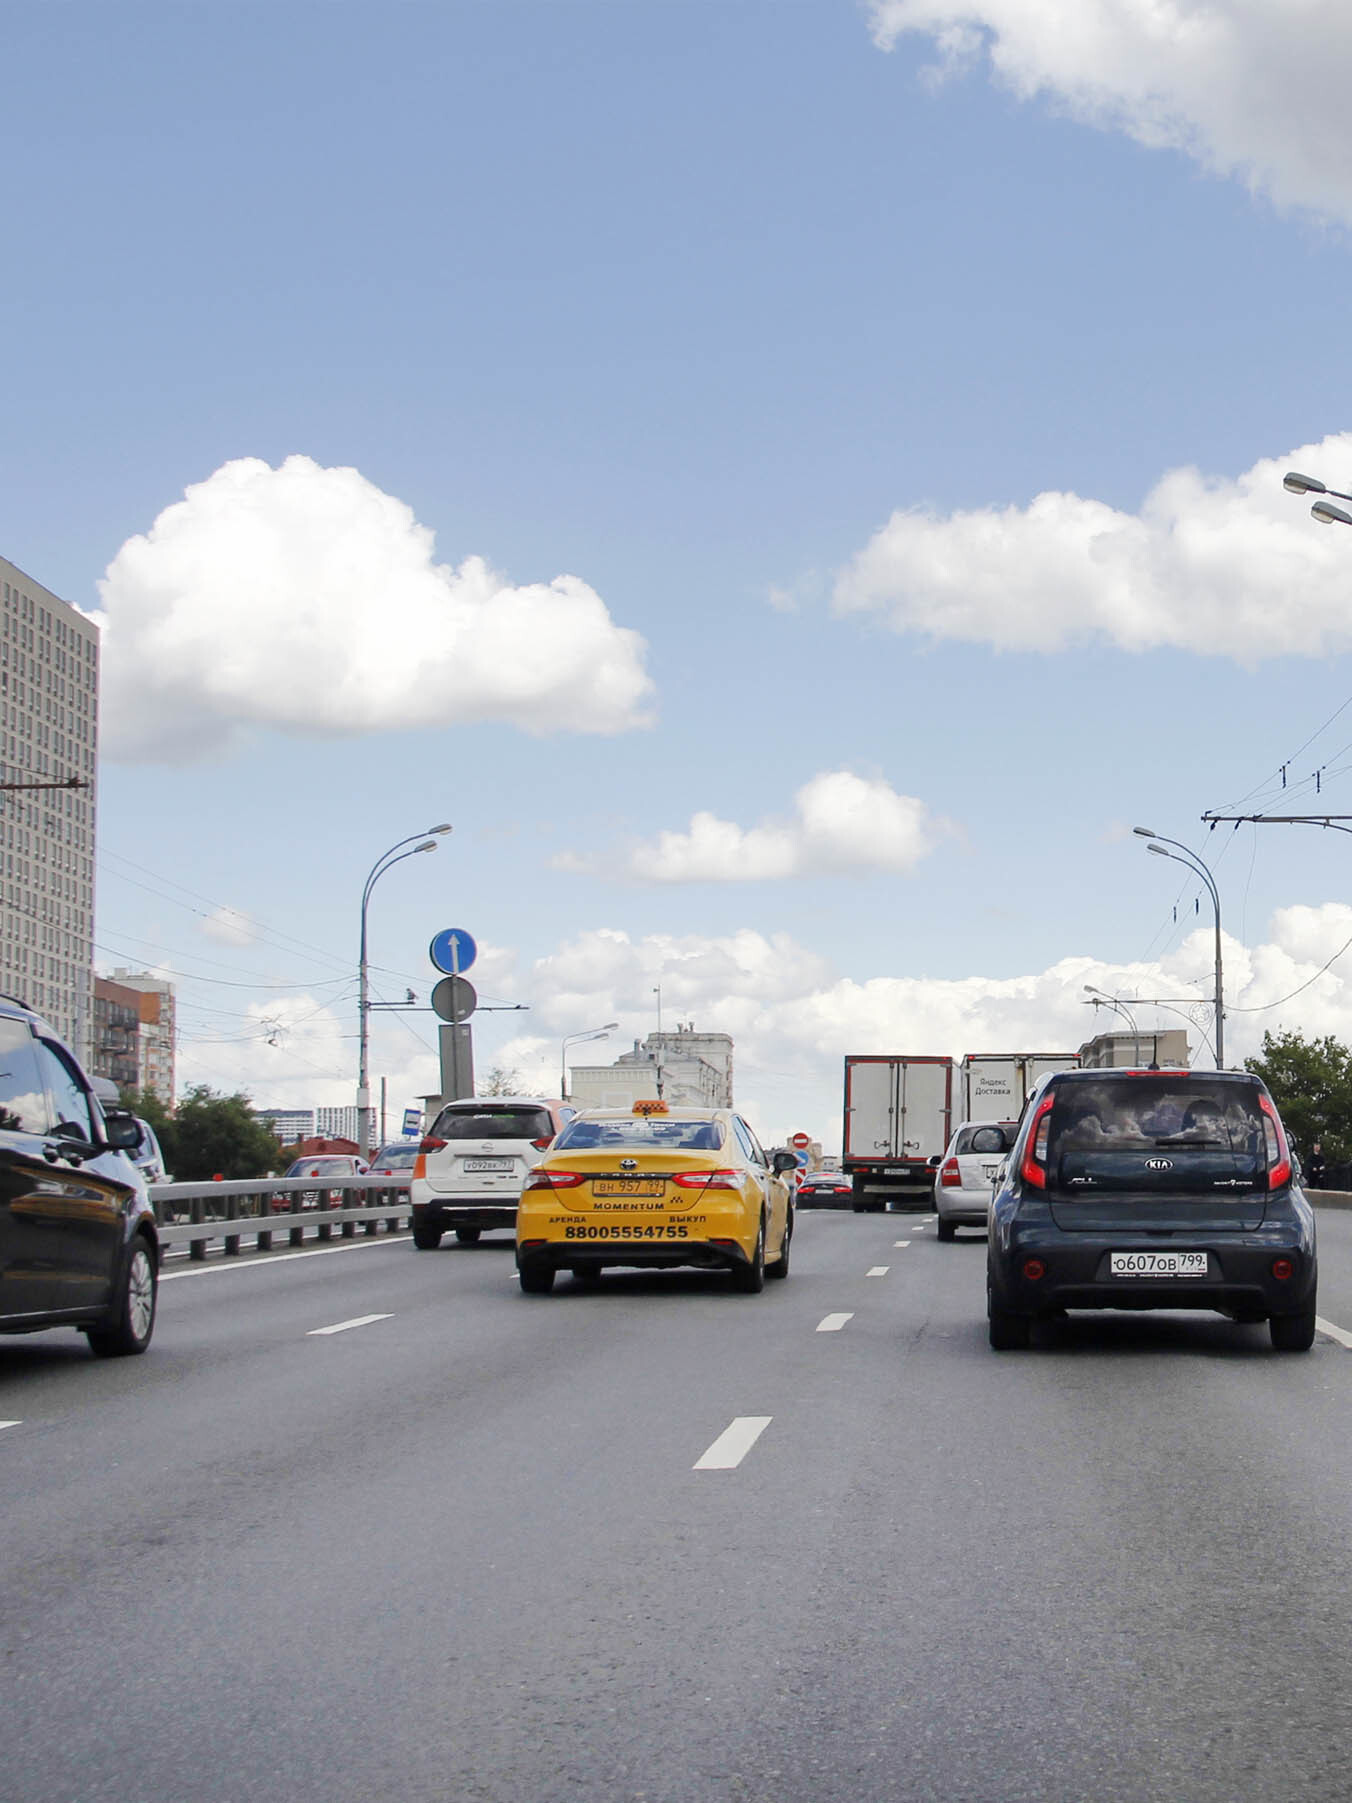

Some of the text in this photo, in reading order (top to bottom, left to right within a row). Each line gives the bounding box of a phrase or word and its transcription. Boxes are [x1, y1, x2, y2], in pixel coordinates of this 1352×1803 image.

[980, 1078, 1007, 1086] Яндекс
[975, 1087, 1011, 1096] Доставка
[1149, 1160, 1169, 1169] KIA
[619, 1180, 641, 1192] 957
[593, 1202, 665, 1210] MOMENTUM
[549, 1215, 707, 1224] АРЕНДА ВЫКУП
[565, 1226, 689, 1239] 88005554755
[1116, 1254, 1203, 1271] О607ОВ 799
